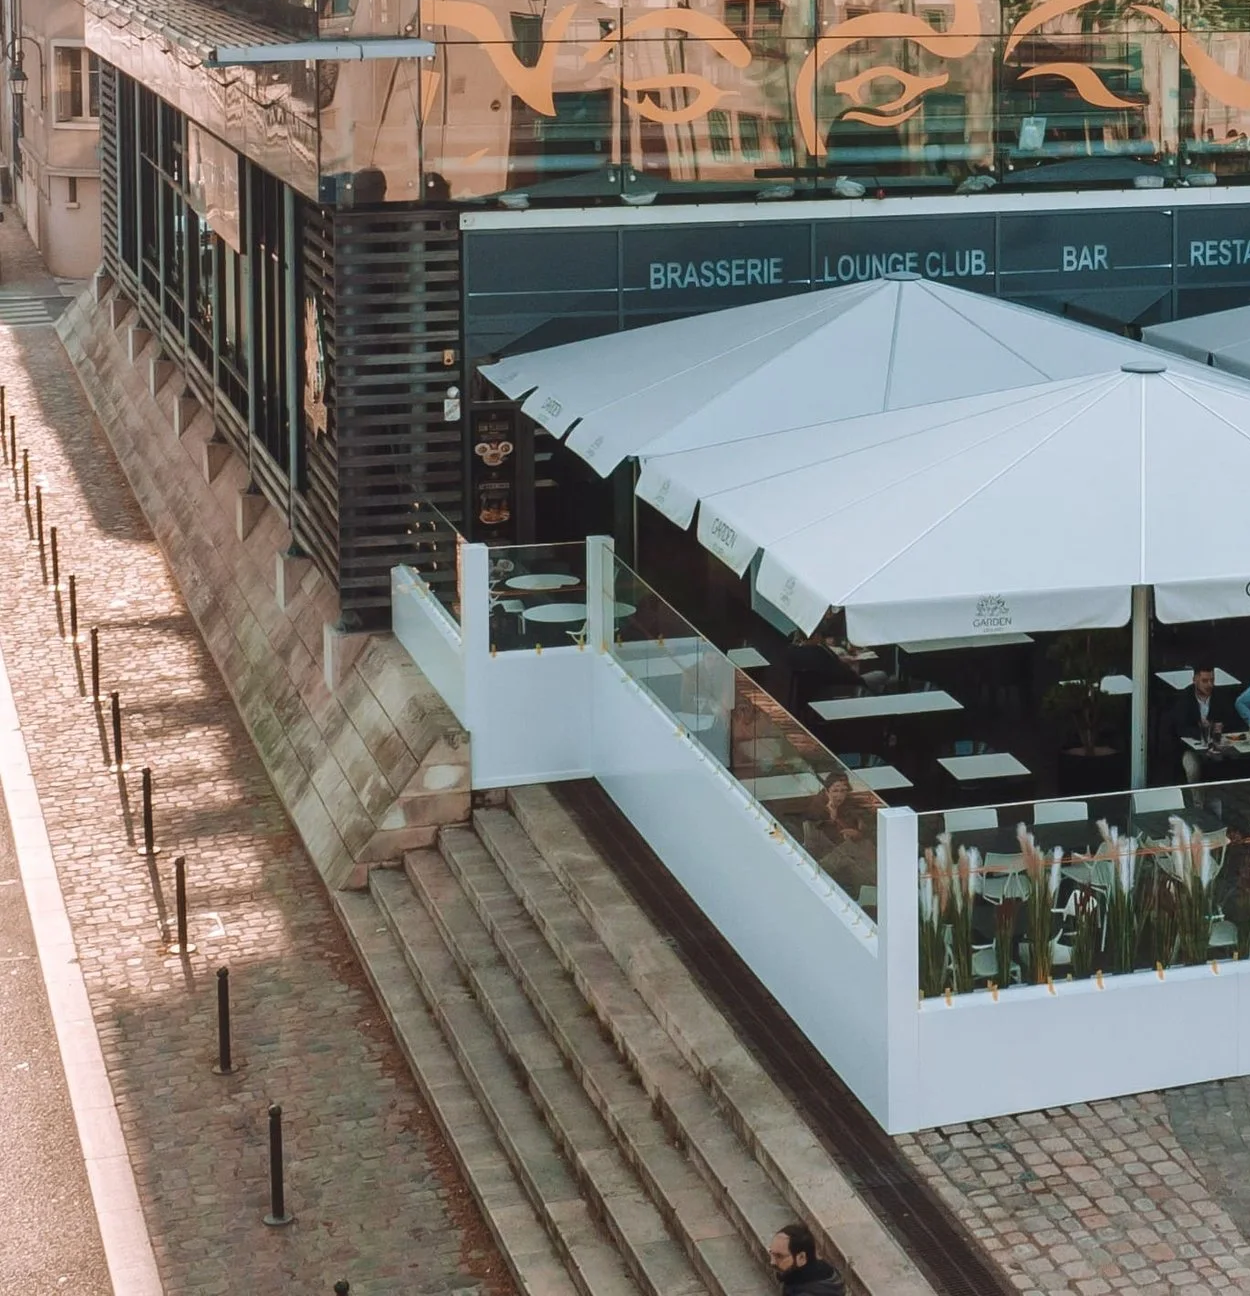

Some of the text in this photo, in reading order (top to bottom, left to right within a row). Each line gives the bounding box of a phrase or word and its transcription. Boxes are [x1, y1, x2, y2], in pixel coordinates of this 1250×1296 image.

[649, 256, 784, 291] BRASSERIE
[823, 249, 987, 283] LOUNGE CLUB
[1062, 244, 1109, 272] BAR
[972, 617, 1013, 628] GARDEN
